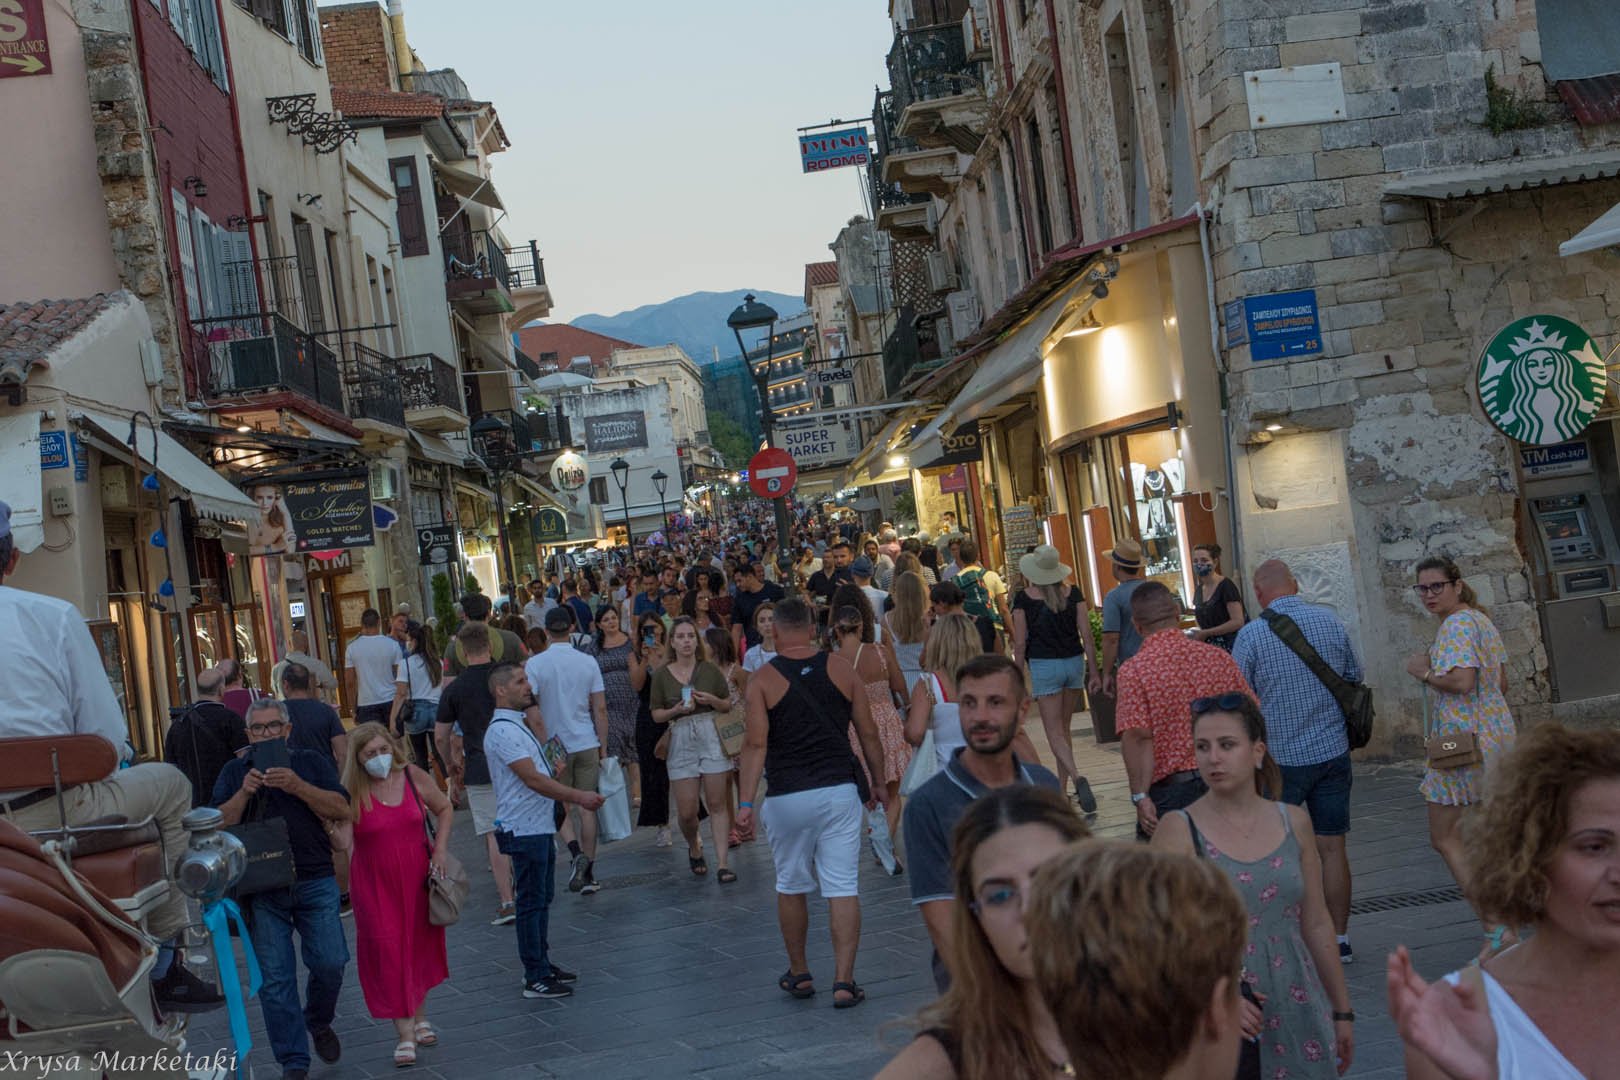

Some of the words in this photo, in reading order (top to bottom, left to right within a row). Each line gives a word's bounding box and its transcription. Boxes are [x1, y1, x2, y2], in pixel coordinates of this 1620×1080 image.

[807, 154, 867, 171] ROOMS
[1280, 344, 1286, 353] 1
[1305, 339, 1318, 350] 25
[817, 368, 852, 382] favela
[785, 429, 829, 445] SUPER
[1568, 448, 1585, 457] 24/7
[287, 483, 316, 496] Panos
[319, 480, 366, 494] Koromilas
[306, 528, 324, 536] GOLD
[332, 525, 363, 533] WATCHES
[421, 530, 434, 550] 9
[434, 534, 450, 542] STR
[291, 605, 303, 615] ATM
